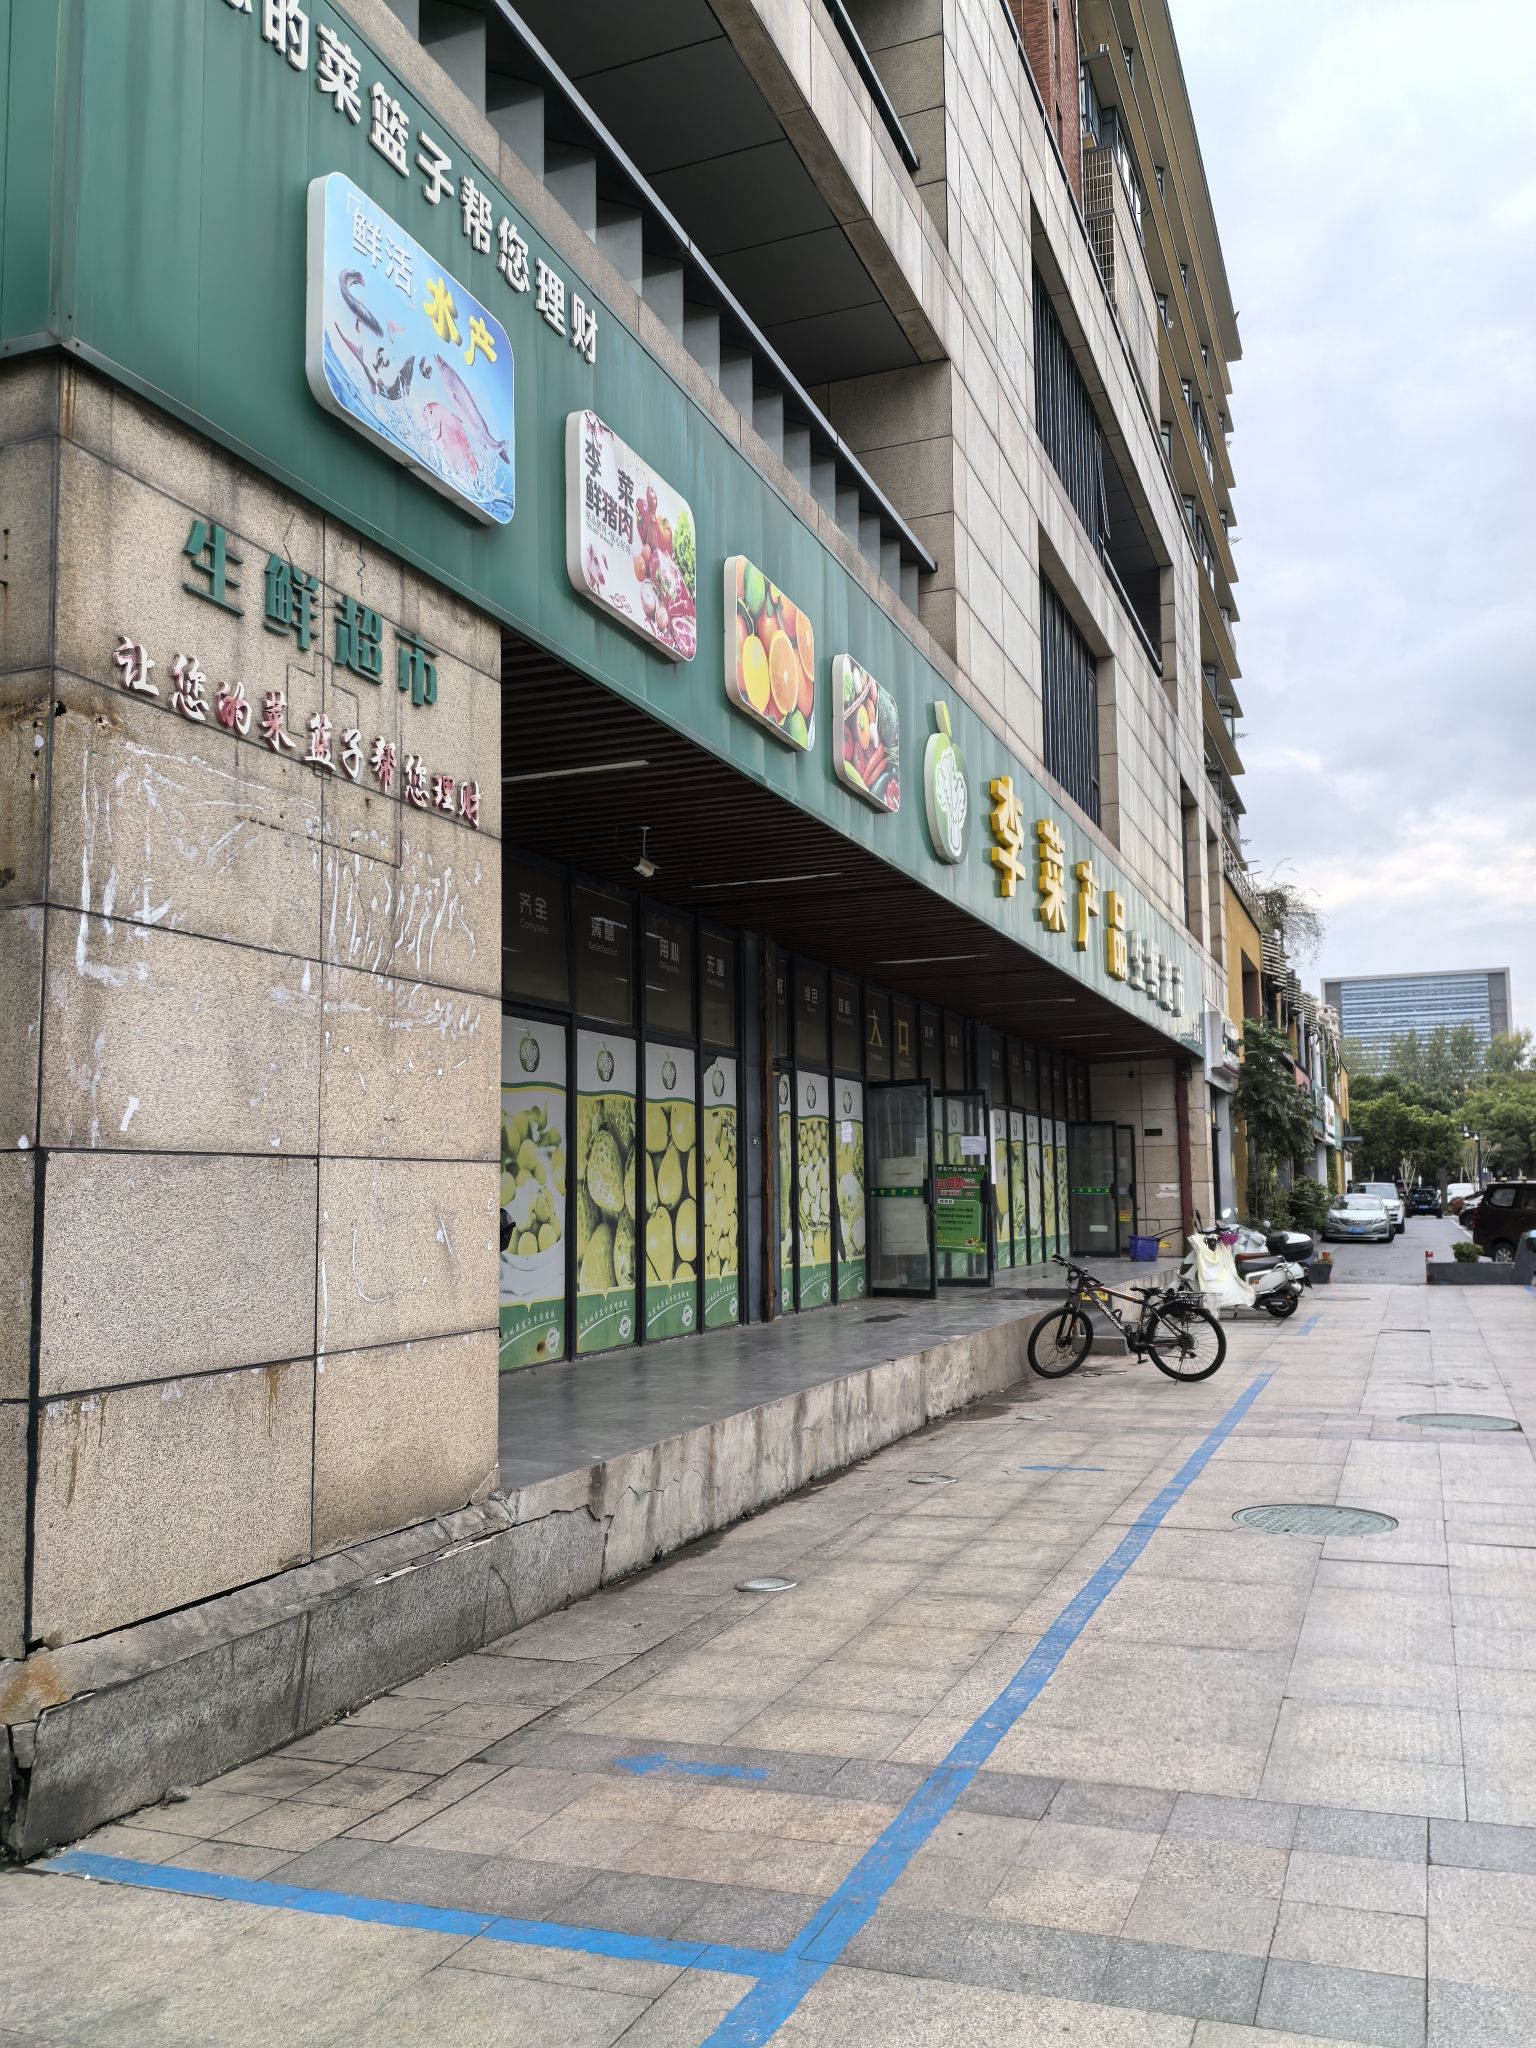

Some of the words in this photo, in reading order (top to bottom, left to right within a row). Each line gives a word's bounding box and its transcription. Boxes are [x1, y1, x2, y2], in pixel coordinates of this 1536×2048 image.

[222, 0, 599, 364] 的菜篮子帮您理财
[352, 206, 414, 298] 鲜活
[423, 276, 497, 367] 水产
[585, 476, 634, 545] 鲜猪肉
[182, 520, 440, 707] 生鲜超市
[112, 635, 482, 829] 让您的菜篮子帮您理财
[519, 892, 548, 921] 齐全
[659, 938, 680, 962] 用心
